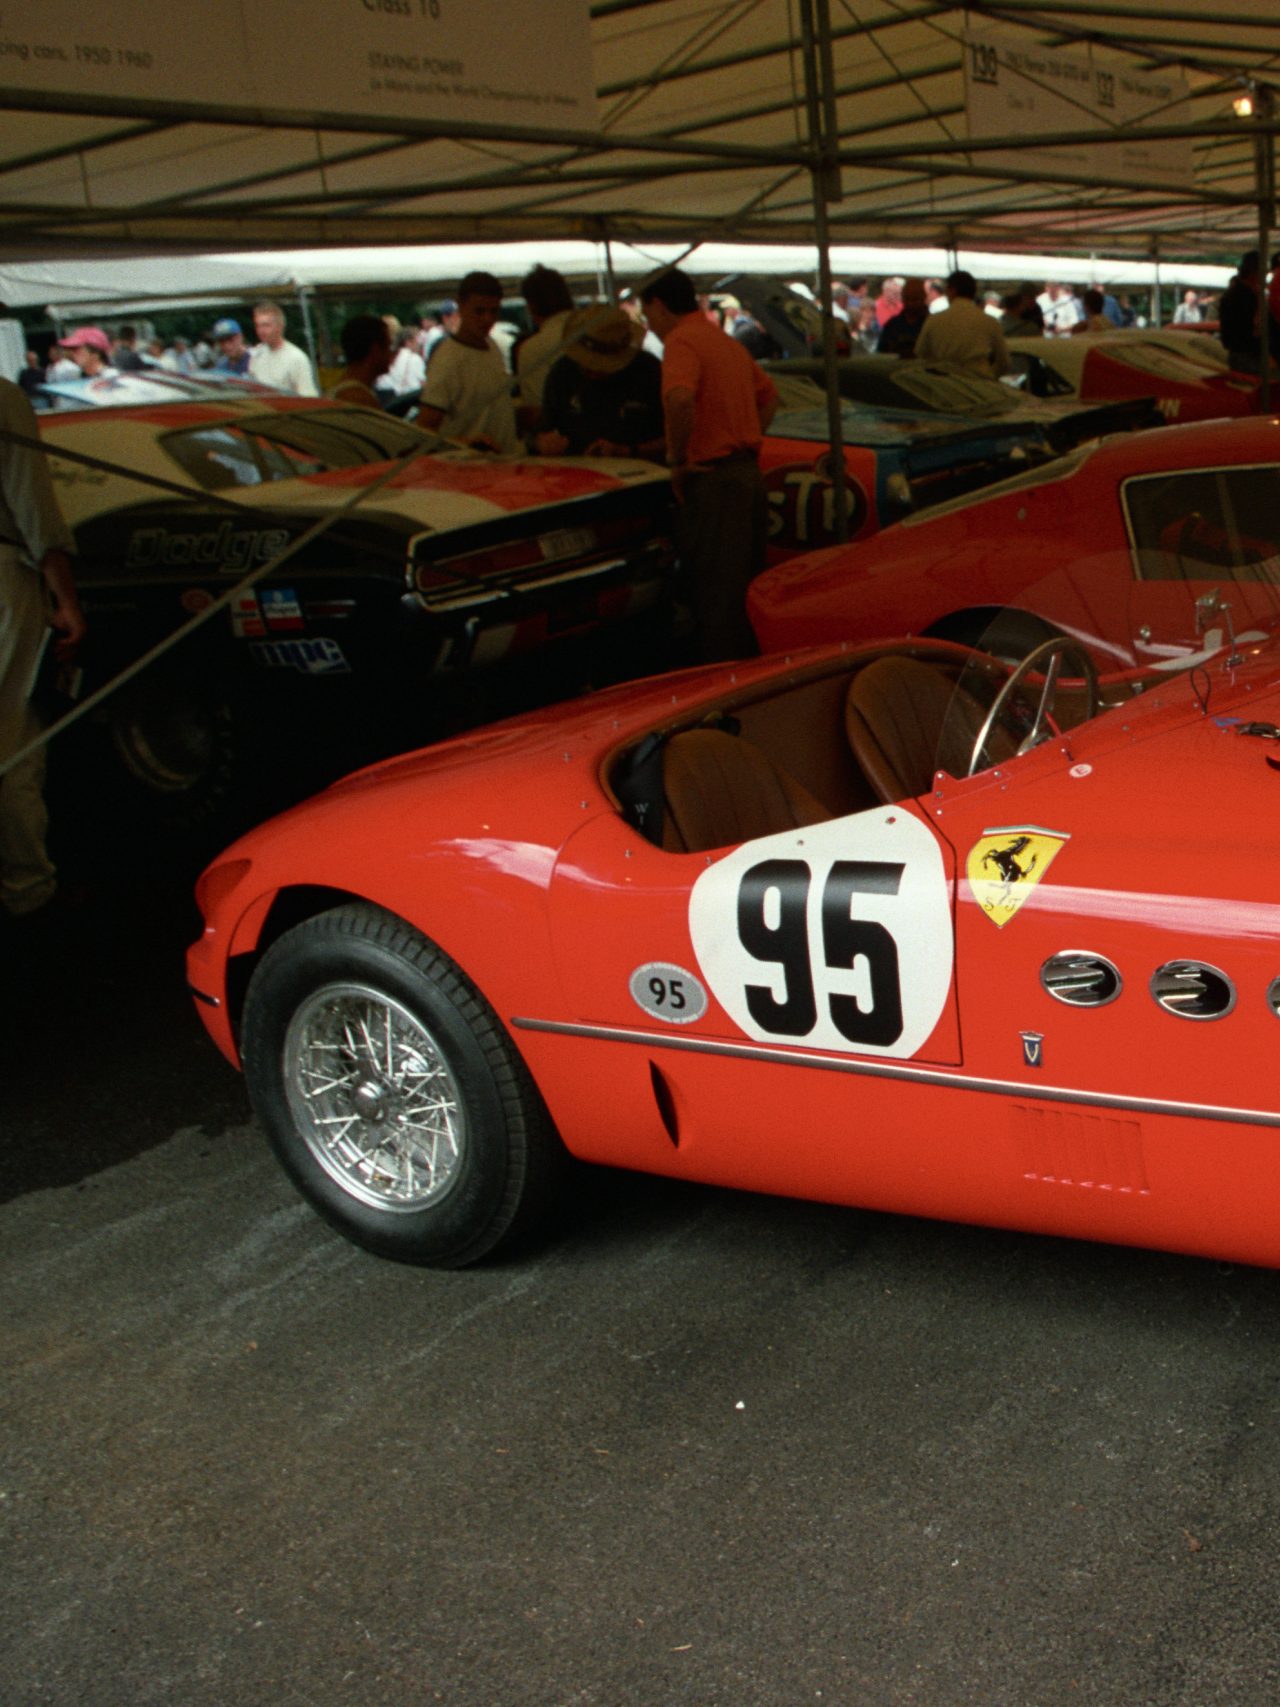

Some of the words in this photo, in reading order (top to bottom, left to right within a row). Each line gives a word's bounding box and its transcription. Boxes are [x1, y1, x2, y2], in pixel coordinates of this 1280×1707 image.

[421, 0, 440, 20] 10
[368, 51, 420, 73] STAYING
[422, 56, 464, 76] POWER
[126, 521, 290, 573] Dodge
[737, 859, 907, 1047] 95
[649, 977, 686, 1010] 95
